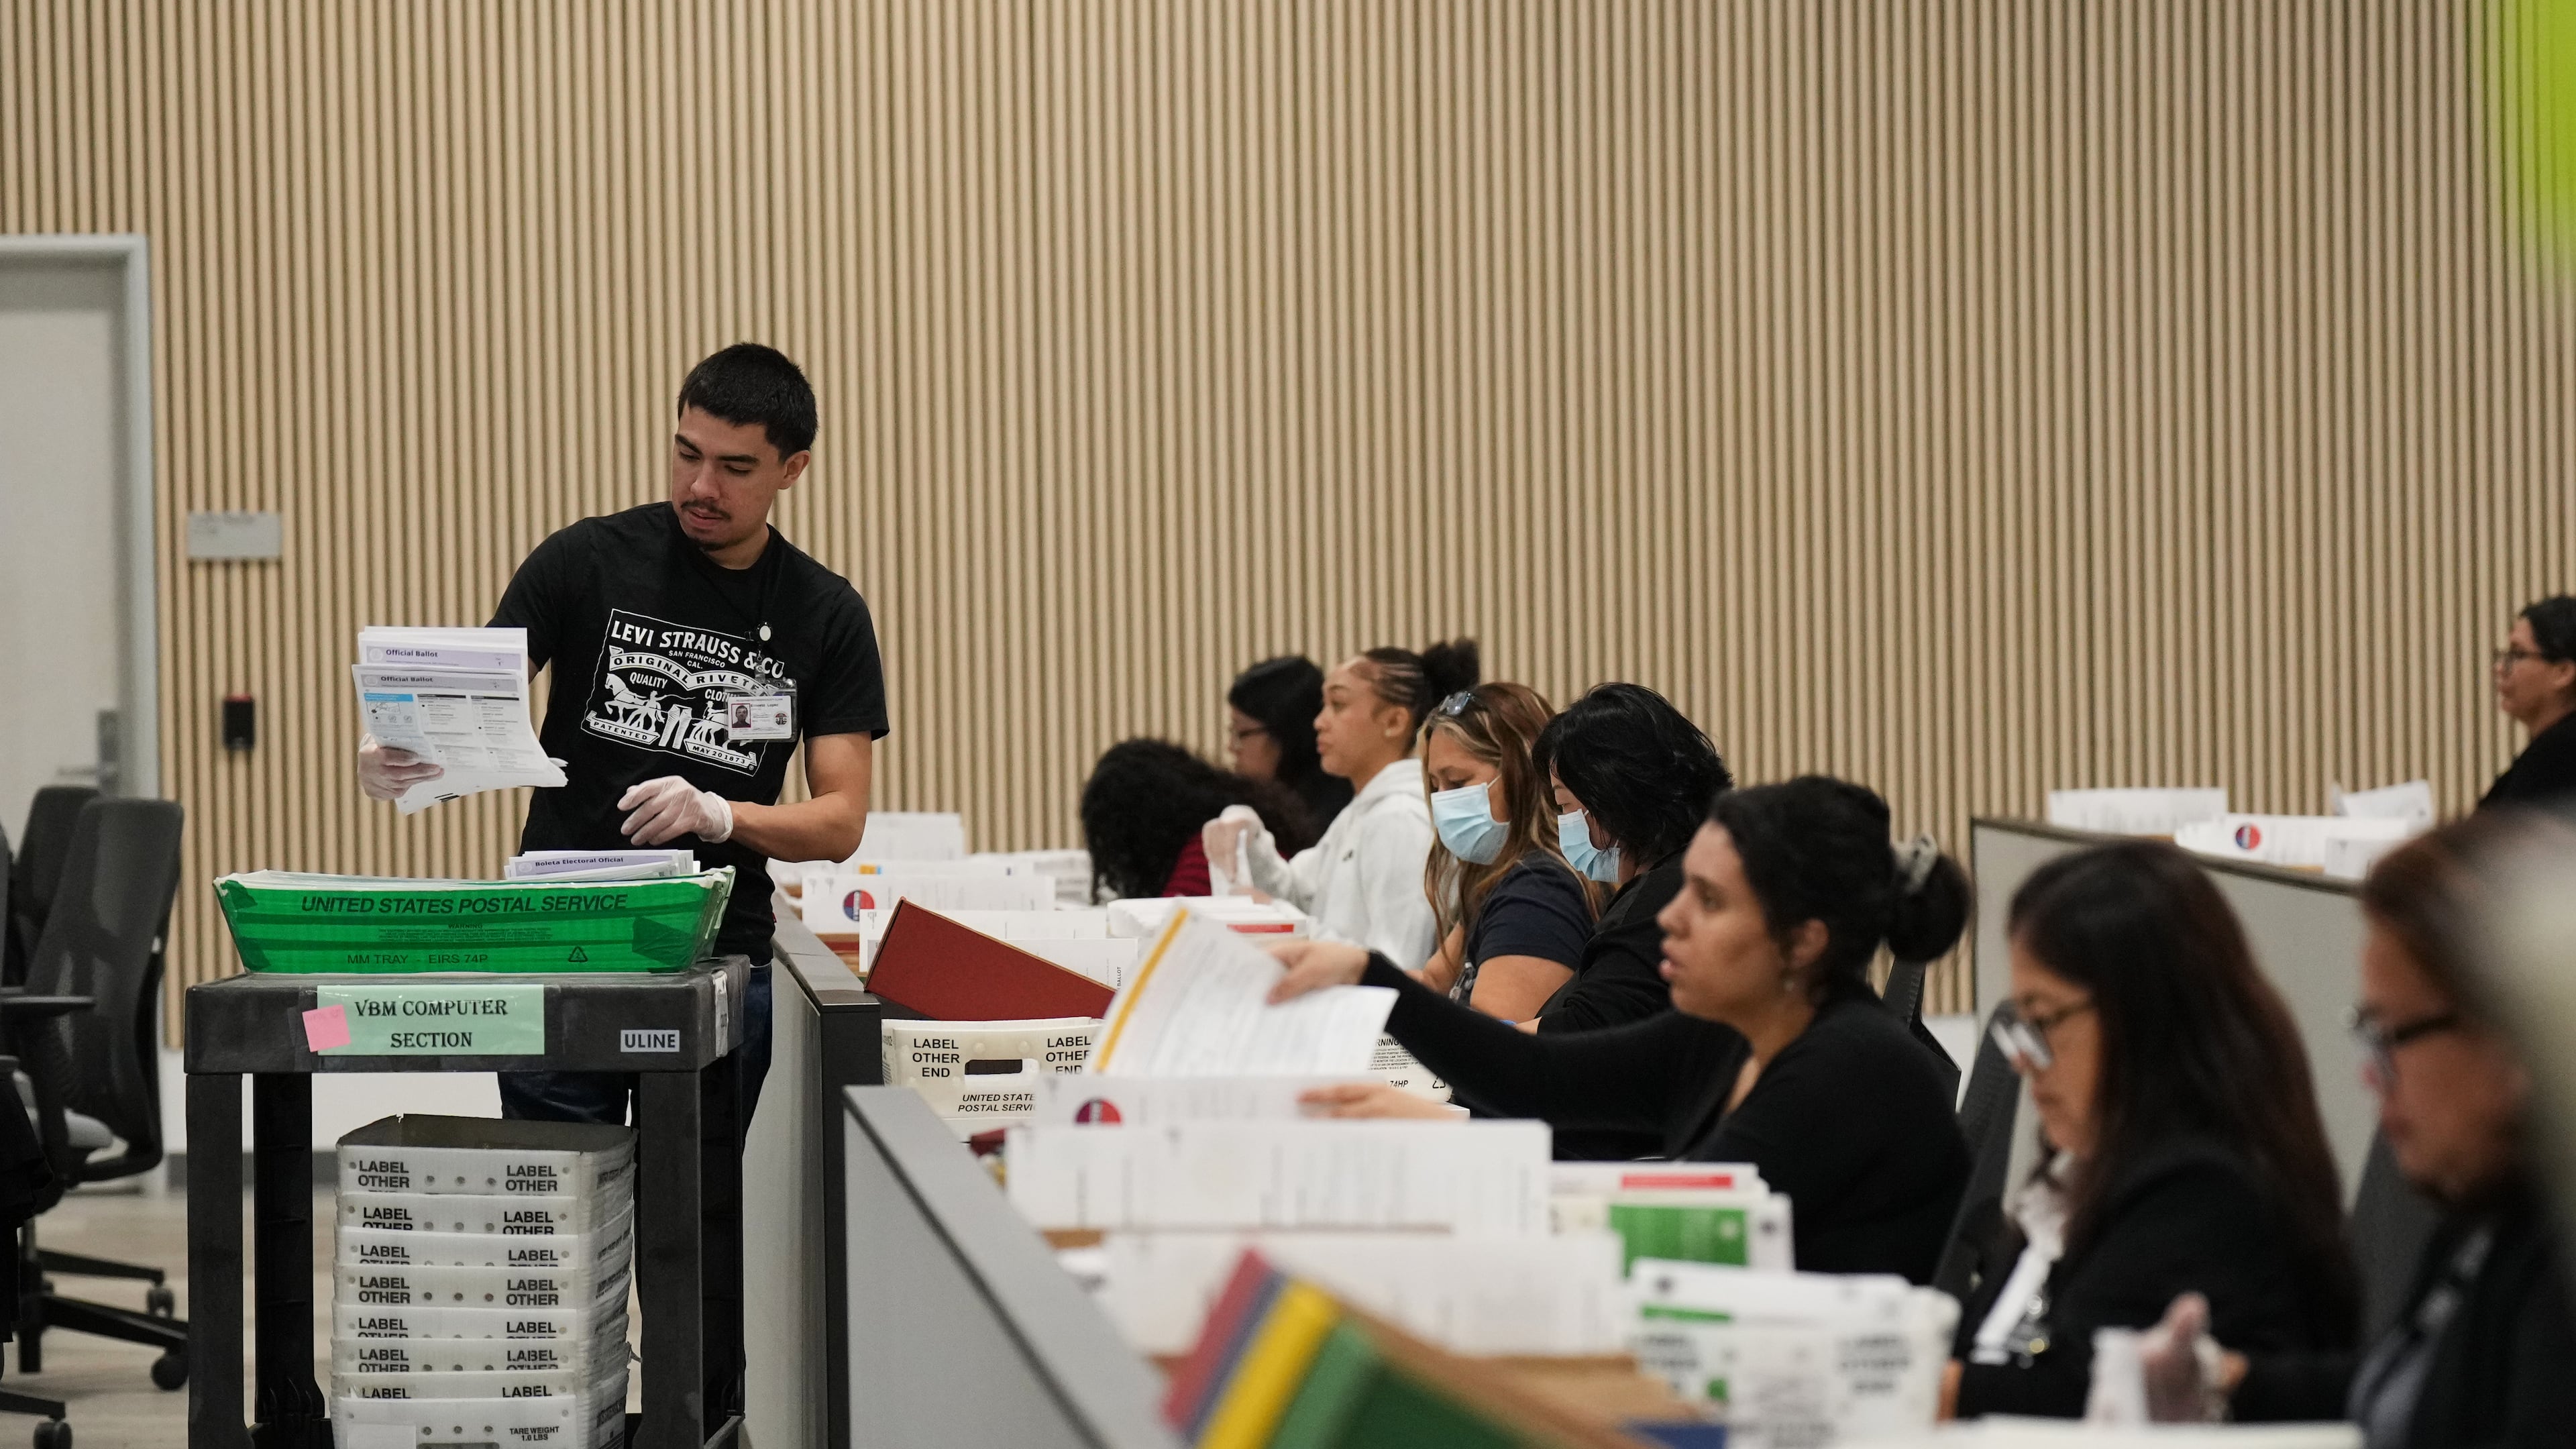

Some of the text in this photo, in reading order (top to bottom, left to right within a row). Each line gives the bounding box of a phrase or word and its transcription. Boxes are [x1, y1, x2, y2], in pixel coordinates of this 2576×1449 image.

[611, 621, 655, 647] LEVI
[659, 631, 741, 663] STRAUSS
[744, 651, 757, 669] &
[684, 652, 726, 668] FRANCISCO
[687, 661, 703, 669] CAL.
[614, 656, 762, 696] ORIGINAL RIVETE
[629, 672, 668, 689] QUALITY
[705, 689, 741, 702] CLOT
[594, 722, 647, 740] PATENTED
[692, 745, 710, 755] MAY
[302, 894, 628, 914] UNITED STATES POSTAL SERVICE
[347, 955, 369, 964] MM
[375, 955, 409, 964] TRAY
[429, 955, 460, 963] EIRS
[464, 954, 488, 963] 74P
[355, 999, 397, 1016] VBM
[402, 1000, 508, 1016] COMPUTER
[390, 1032, 472, 1048] SECTION
[625, 1034, 676, 1048] ULINE
[914, 1038, 959, 1049] LABEL
[1047, 1036, 1091, 1048] LABEL
[1376, 1038, 1400, 1046] RNING
[912, 1053, 960, 1063] OTHER
[922, 1067, 951, 1077] END
[1055, 1065, 1083, 1075] END
[1003, 1093, 1036, 1102] STATE
[958, 1104, 999, 1112] POSTAL
[359, 1160, 409, 1173] LABEL
[506, 1165, 557, 1177] LABEL
[358, 1175, 410, 1188] OTHER
[505, 1180, 557, 1191] OTHER
[363, 1207, 413, 1220] LABEL
[504, 1212, 554, 1223] LABEL
[502, 1226, 555, 1235] OTHER
[360, 1244, 410, 1258] LABEL
[508, 1250, 559, 1261] LABEL
[360, 1277, 410, 1289] LABEL
[507, 1279, 558, 1291] LABEL
[358, 1291, 411, 1304] OTHER
[506, 1293, 559, 1305] OTHER
[358, 1318, 408, 1330] LABEL
[506, 1322, 557, 1333] LABEL
[360, 1348, 409, 1361] LABEL
[507, 1349, 558, 1362] LABEL
[358, 1362, 410, 1373] OTHER
[362, 1387, 412, 1399] LABEL
[502, 1385, 552, 1398] LABEL
[530, 1426, 559, 1434] WEIGHT
